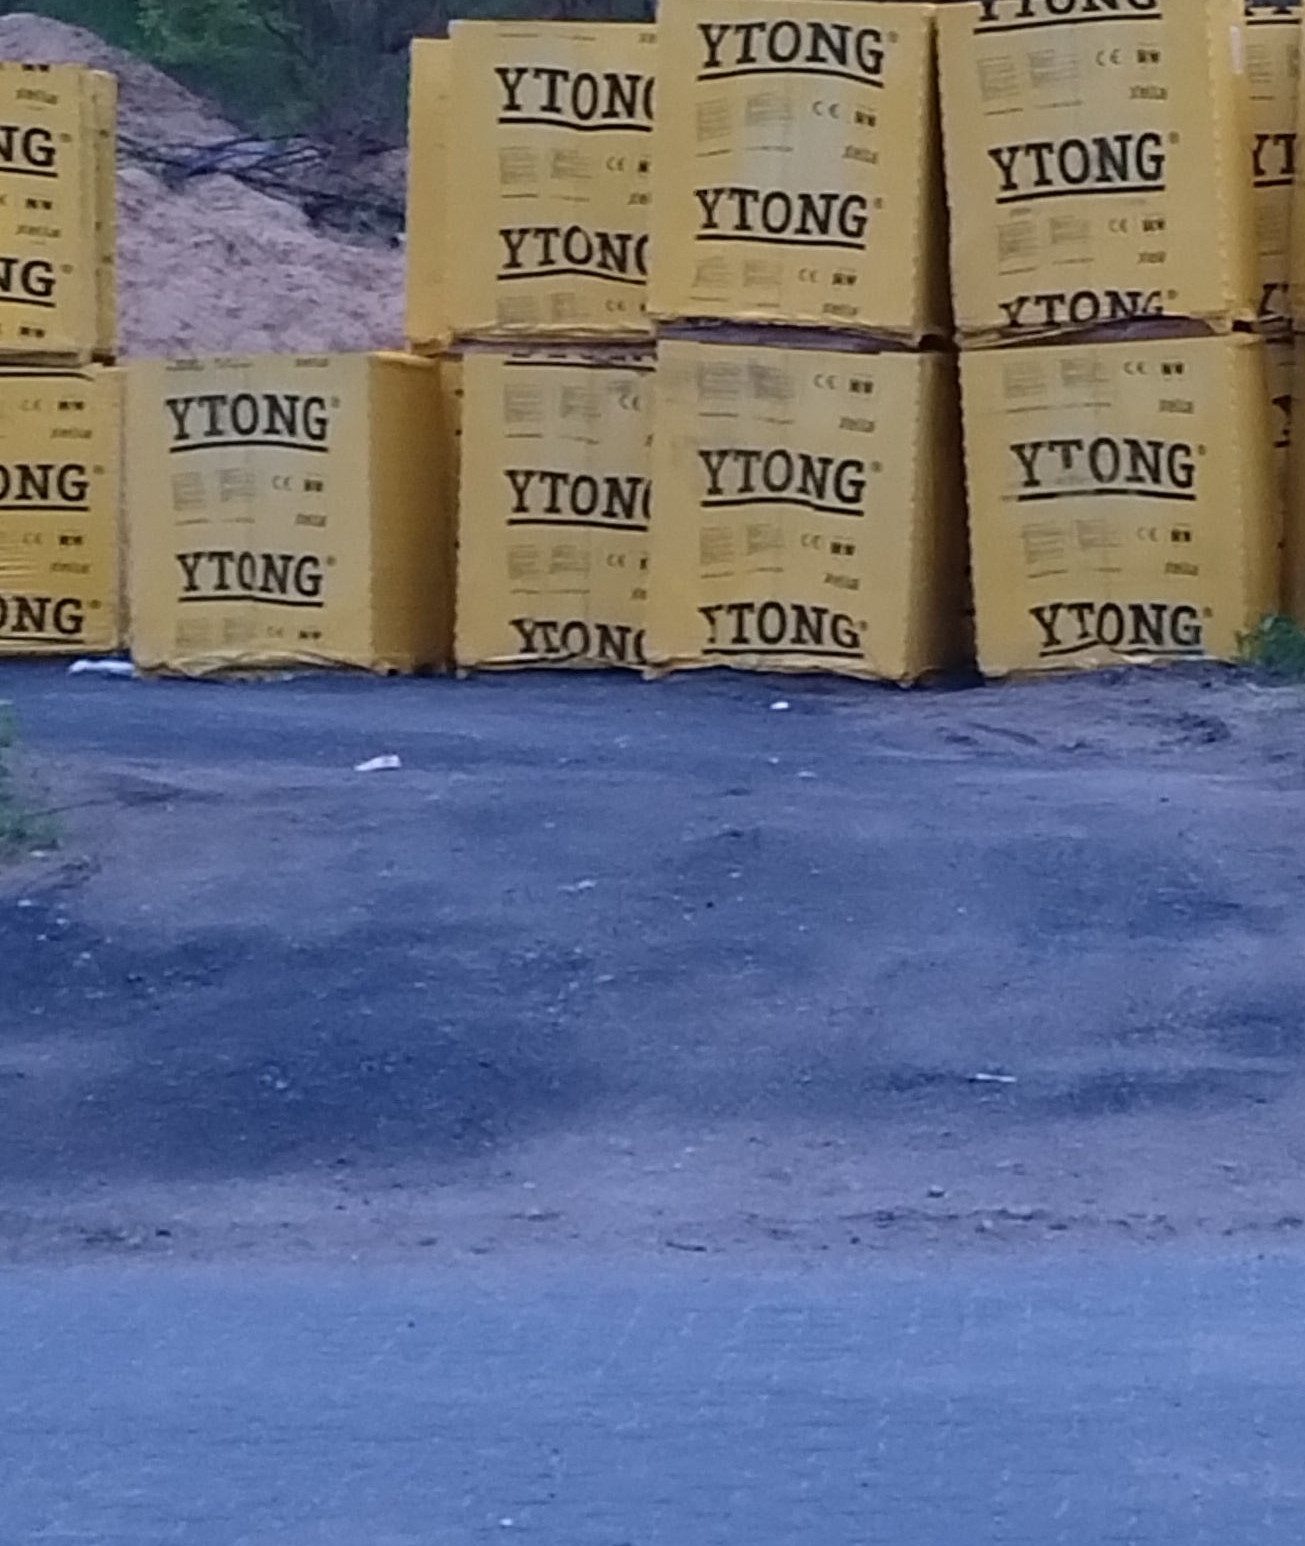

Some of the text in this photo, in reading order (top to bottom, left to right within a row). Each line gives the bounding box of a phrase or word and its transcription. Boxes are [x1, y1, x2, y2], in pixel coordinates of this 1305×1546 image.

[698, 21, 884, 74] YTONG
[988, 133, 1165, 191] YTONG
[695, 188, 867, 238] YTONG
[166, 394, 327, 441] YTONG
[698, 449, 866, 504] YTONG
[177, 551, 322, 597] YTONG
[509, 619, 648, 663] YTON
